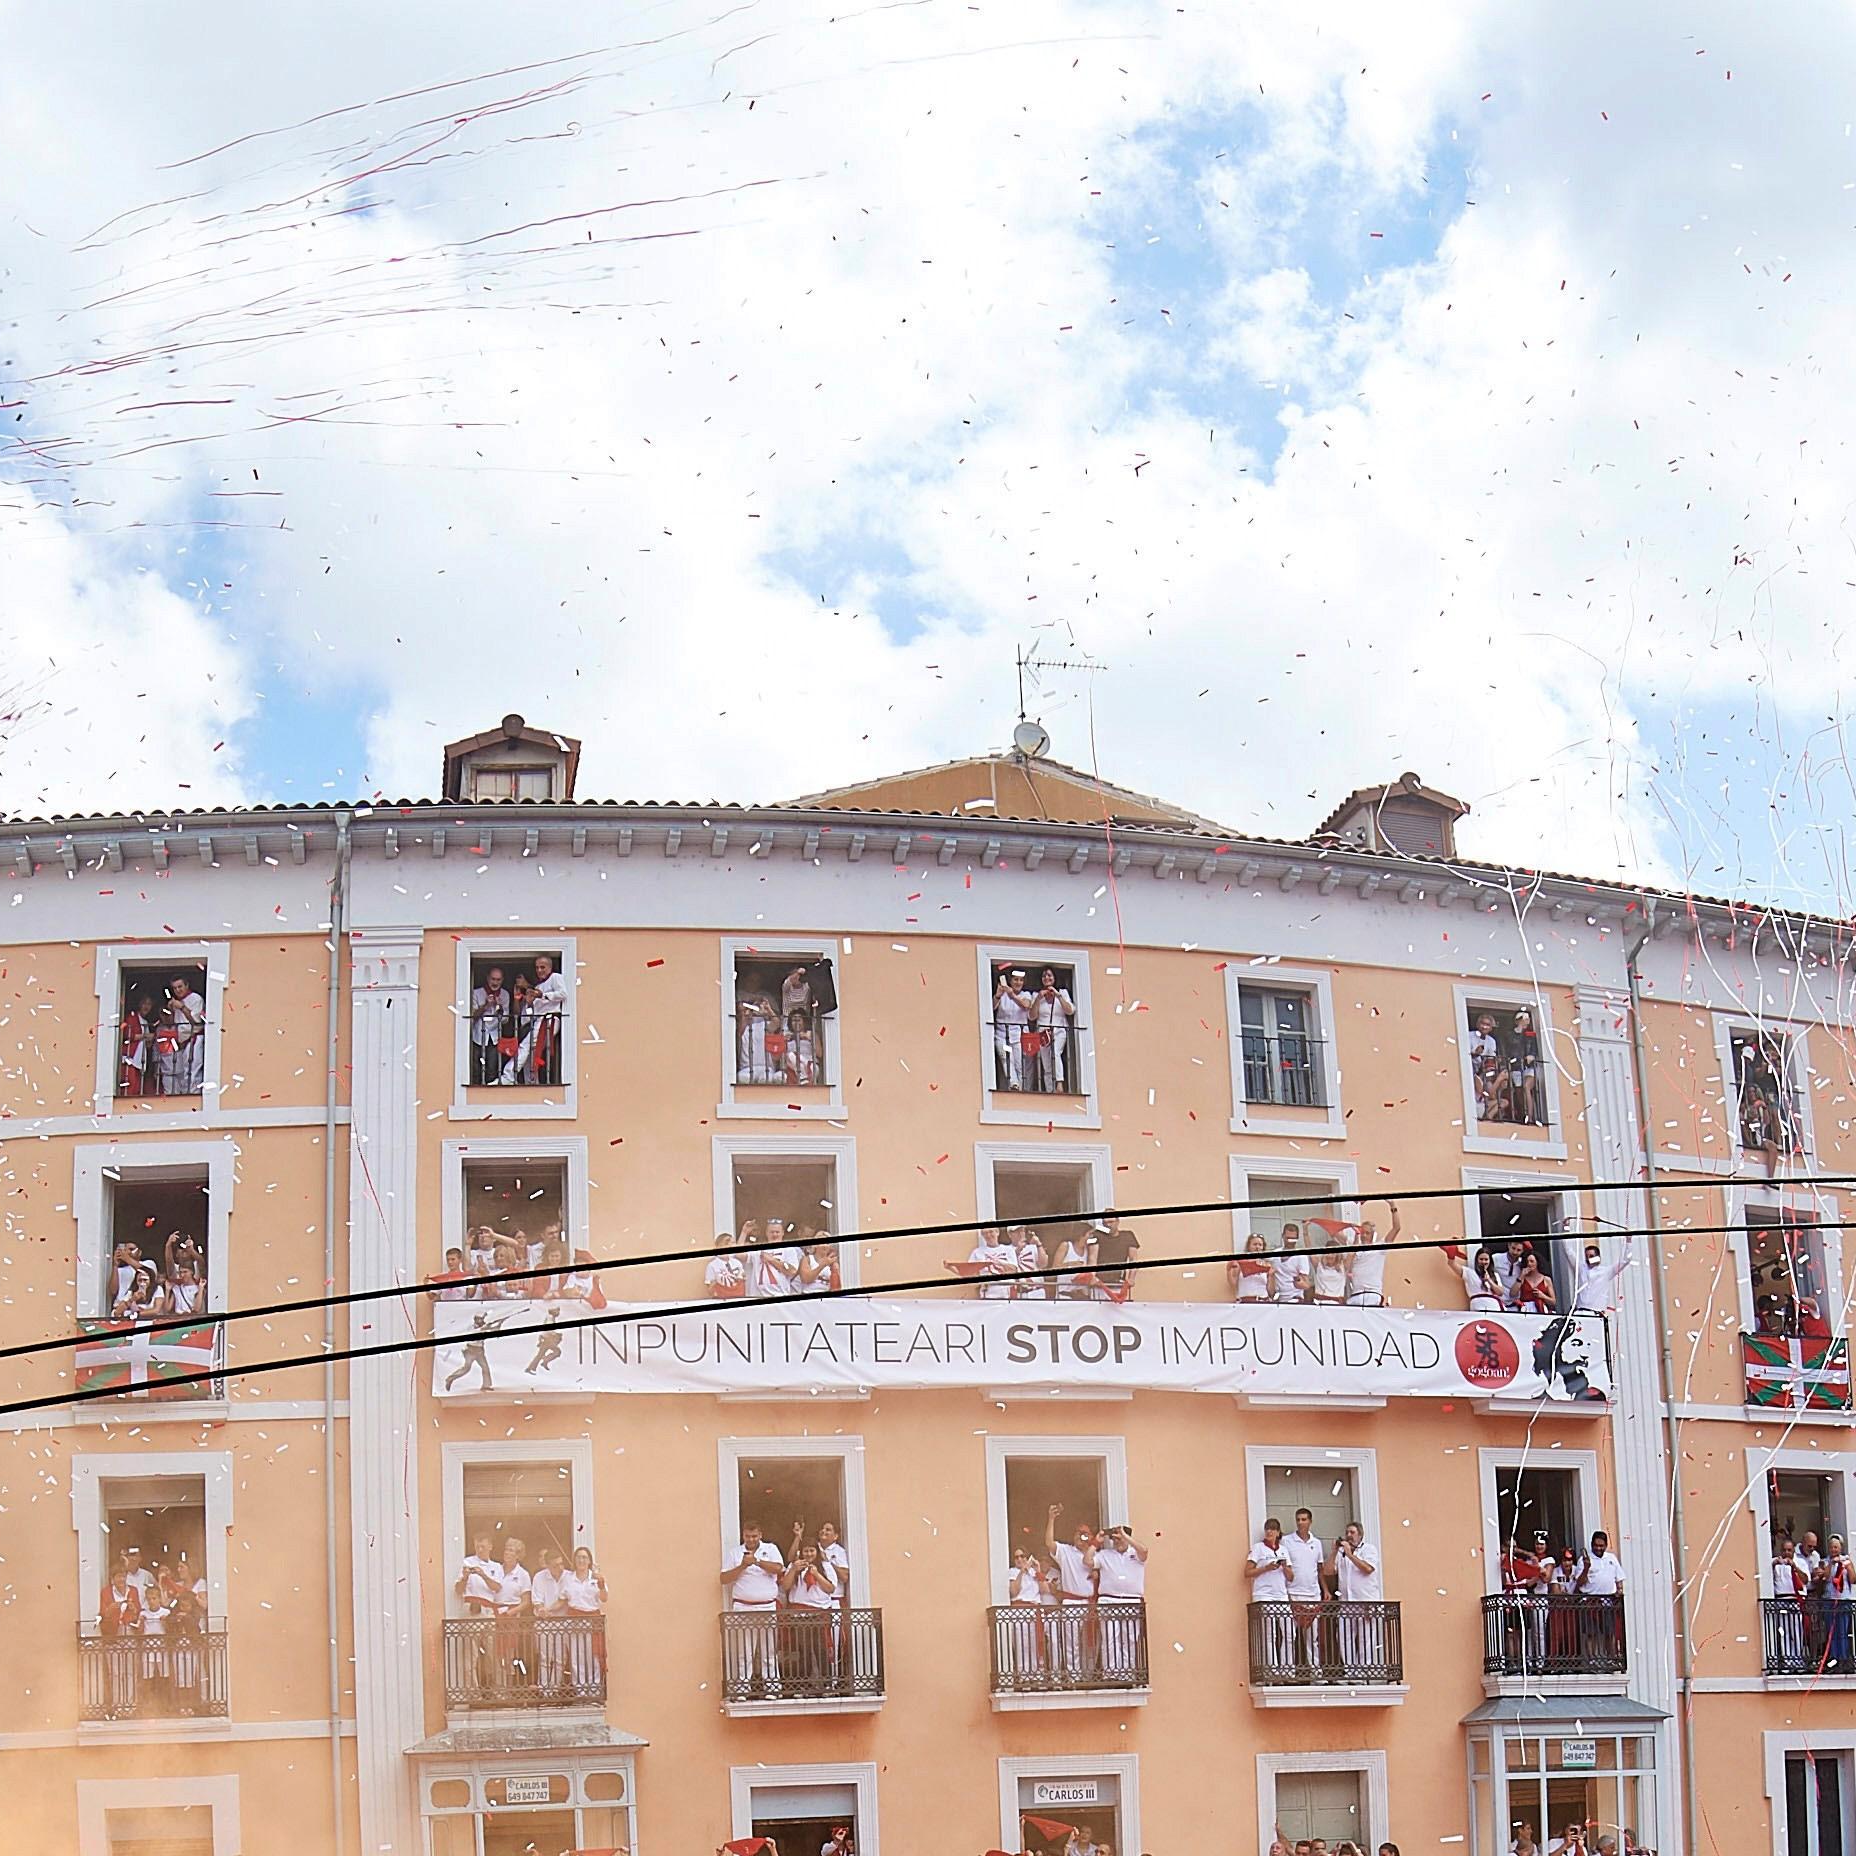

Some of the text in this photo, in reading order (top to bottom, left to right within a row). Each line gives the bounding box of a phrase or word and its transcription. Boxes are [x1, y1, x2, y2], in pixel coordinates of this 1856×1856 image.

[577, 1321, 1441, 1370] INPUNITATEARI STOP IMPUNIDAD
[1049, 1788, 1095, 1801] CARLOS III
